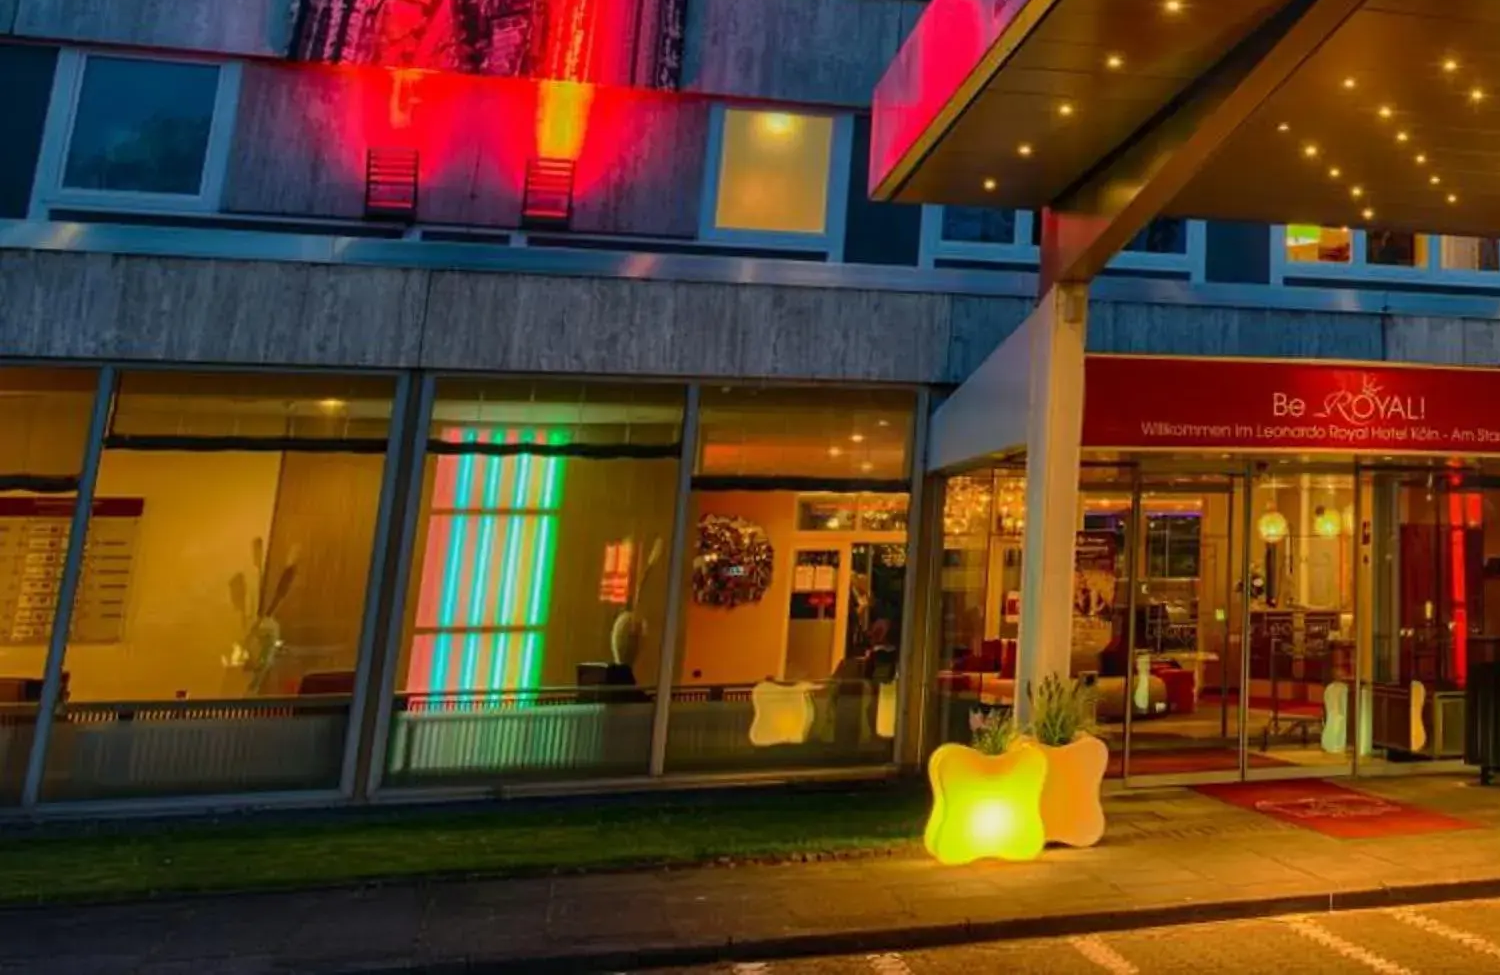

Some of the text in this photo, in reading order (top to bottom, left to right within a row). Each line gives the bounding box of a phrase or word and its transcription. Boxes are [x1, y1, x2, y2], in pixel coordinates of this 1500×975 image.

[1272, 389, 1425, 425] Be ROYAL!
[1140, 421, 1231, 438] Willkommen
[1256, 424, 1326, 440] Leonardo
[1329, 426, 1369, 442] Royal
[1371, 426, 1408, 440] Hotel
[1411, 426, 1439, 441] Köln
[1451, 429, 1474, 442] Am
